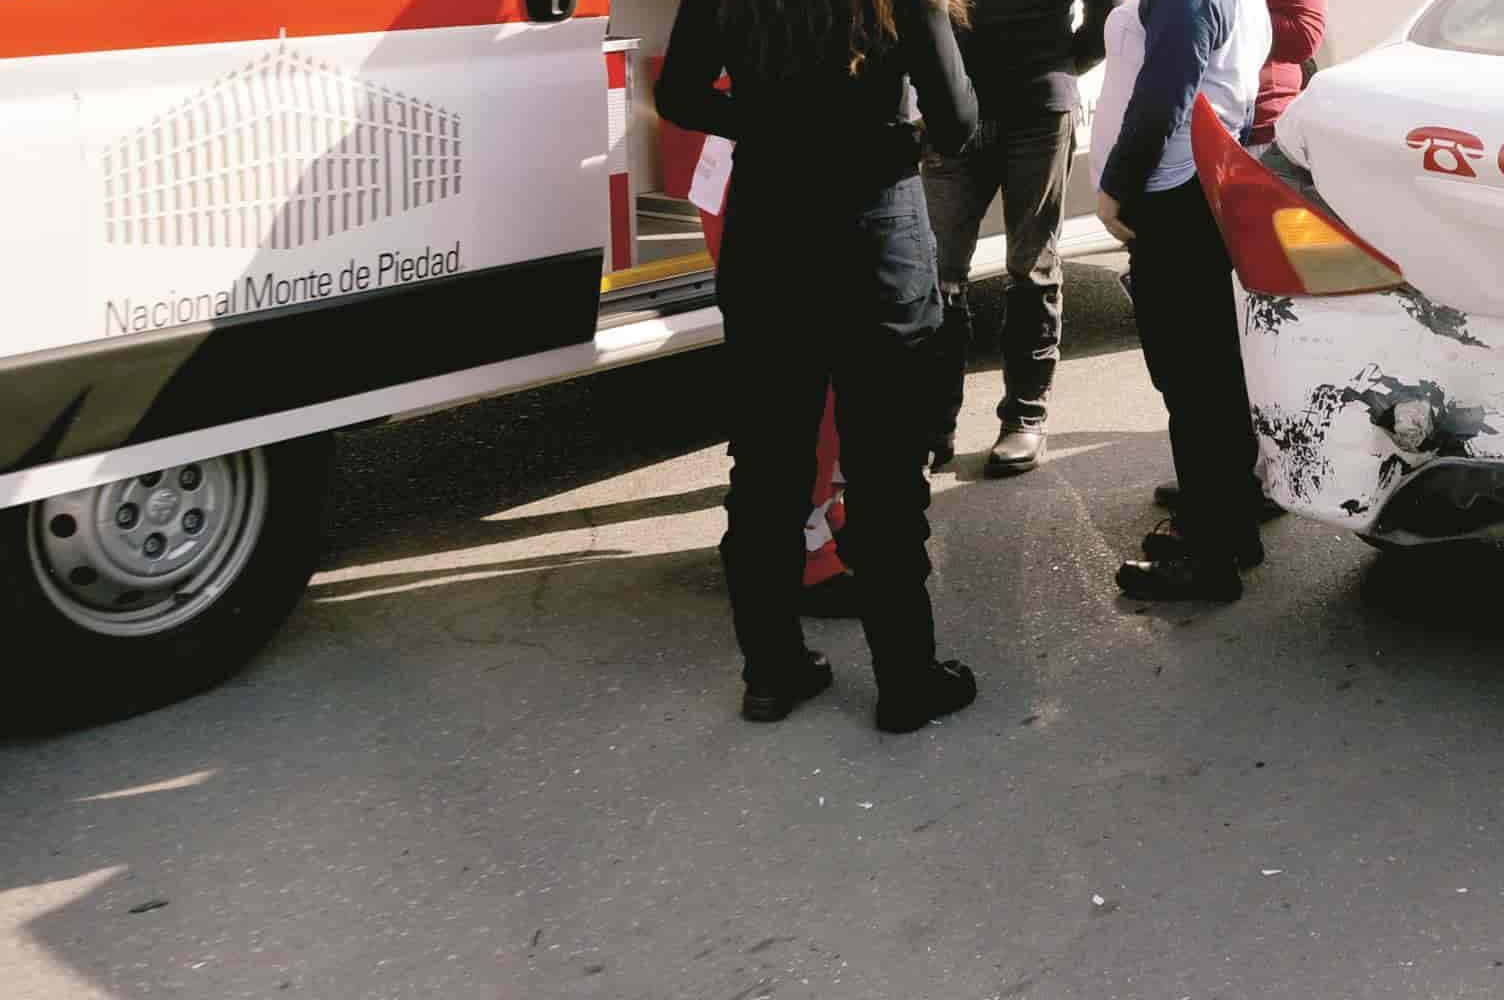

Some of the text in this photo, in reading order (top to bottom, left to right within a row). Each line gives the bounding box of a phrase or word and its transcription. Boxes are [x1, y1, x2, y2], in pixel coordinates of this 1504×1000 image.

[103, 239, 461, 337] Nacional Monte de Piedad
